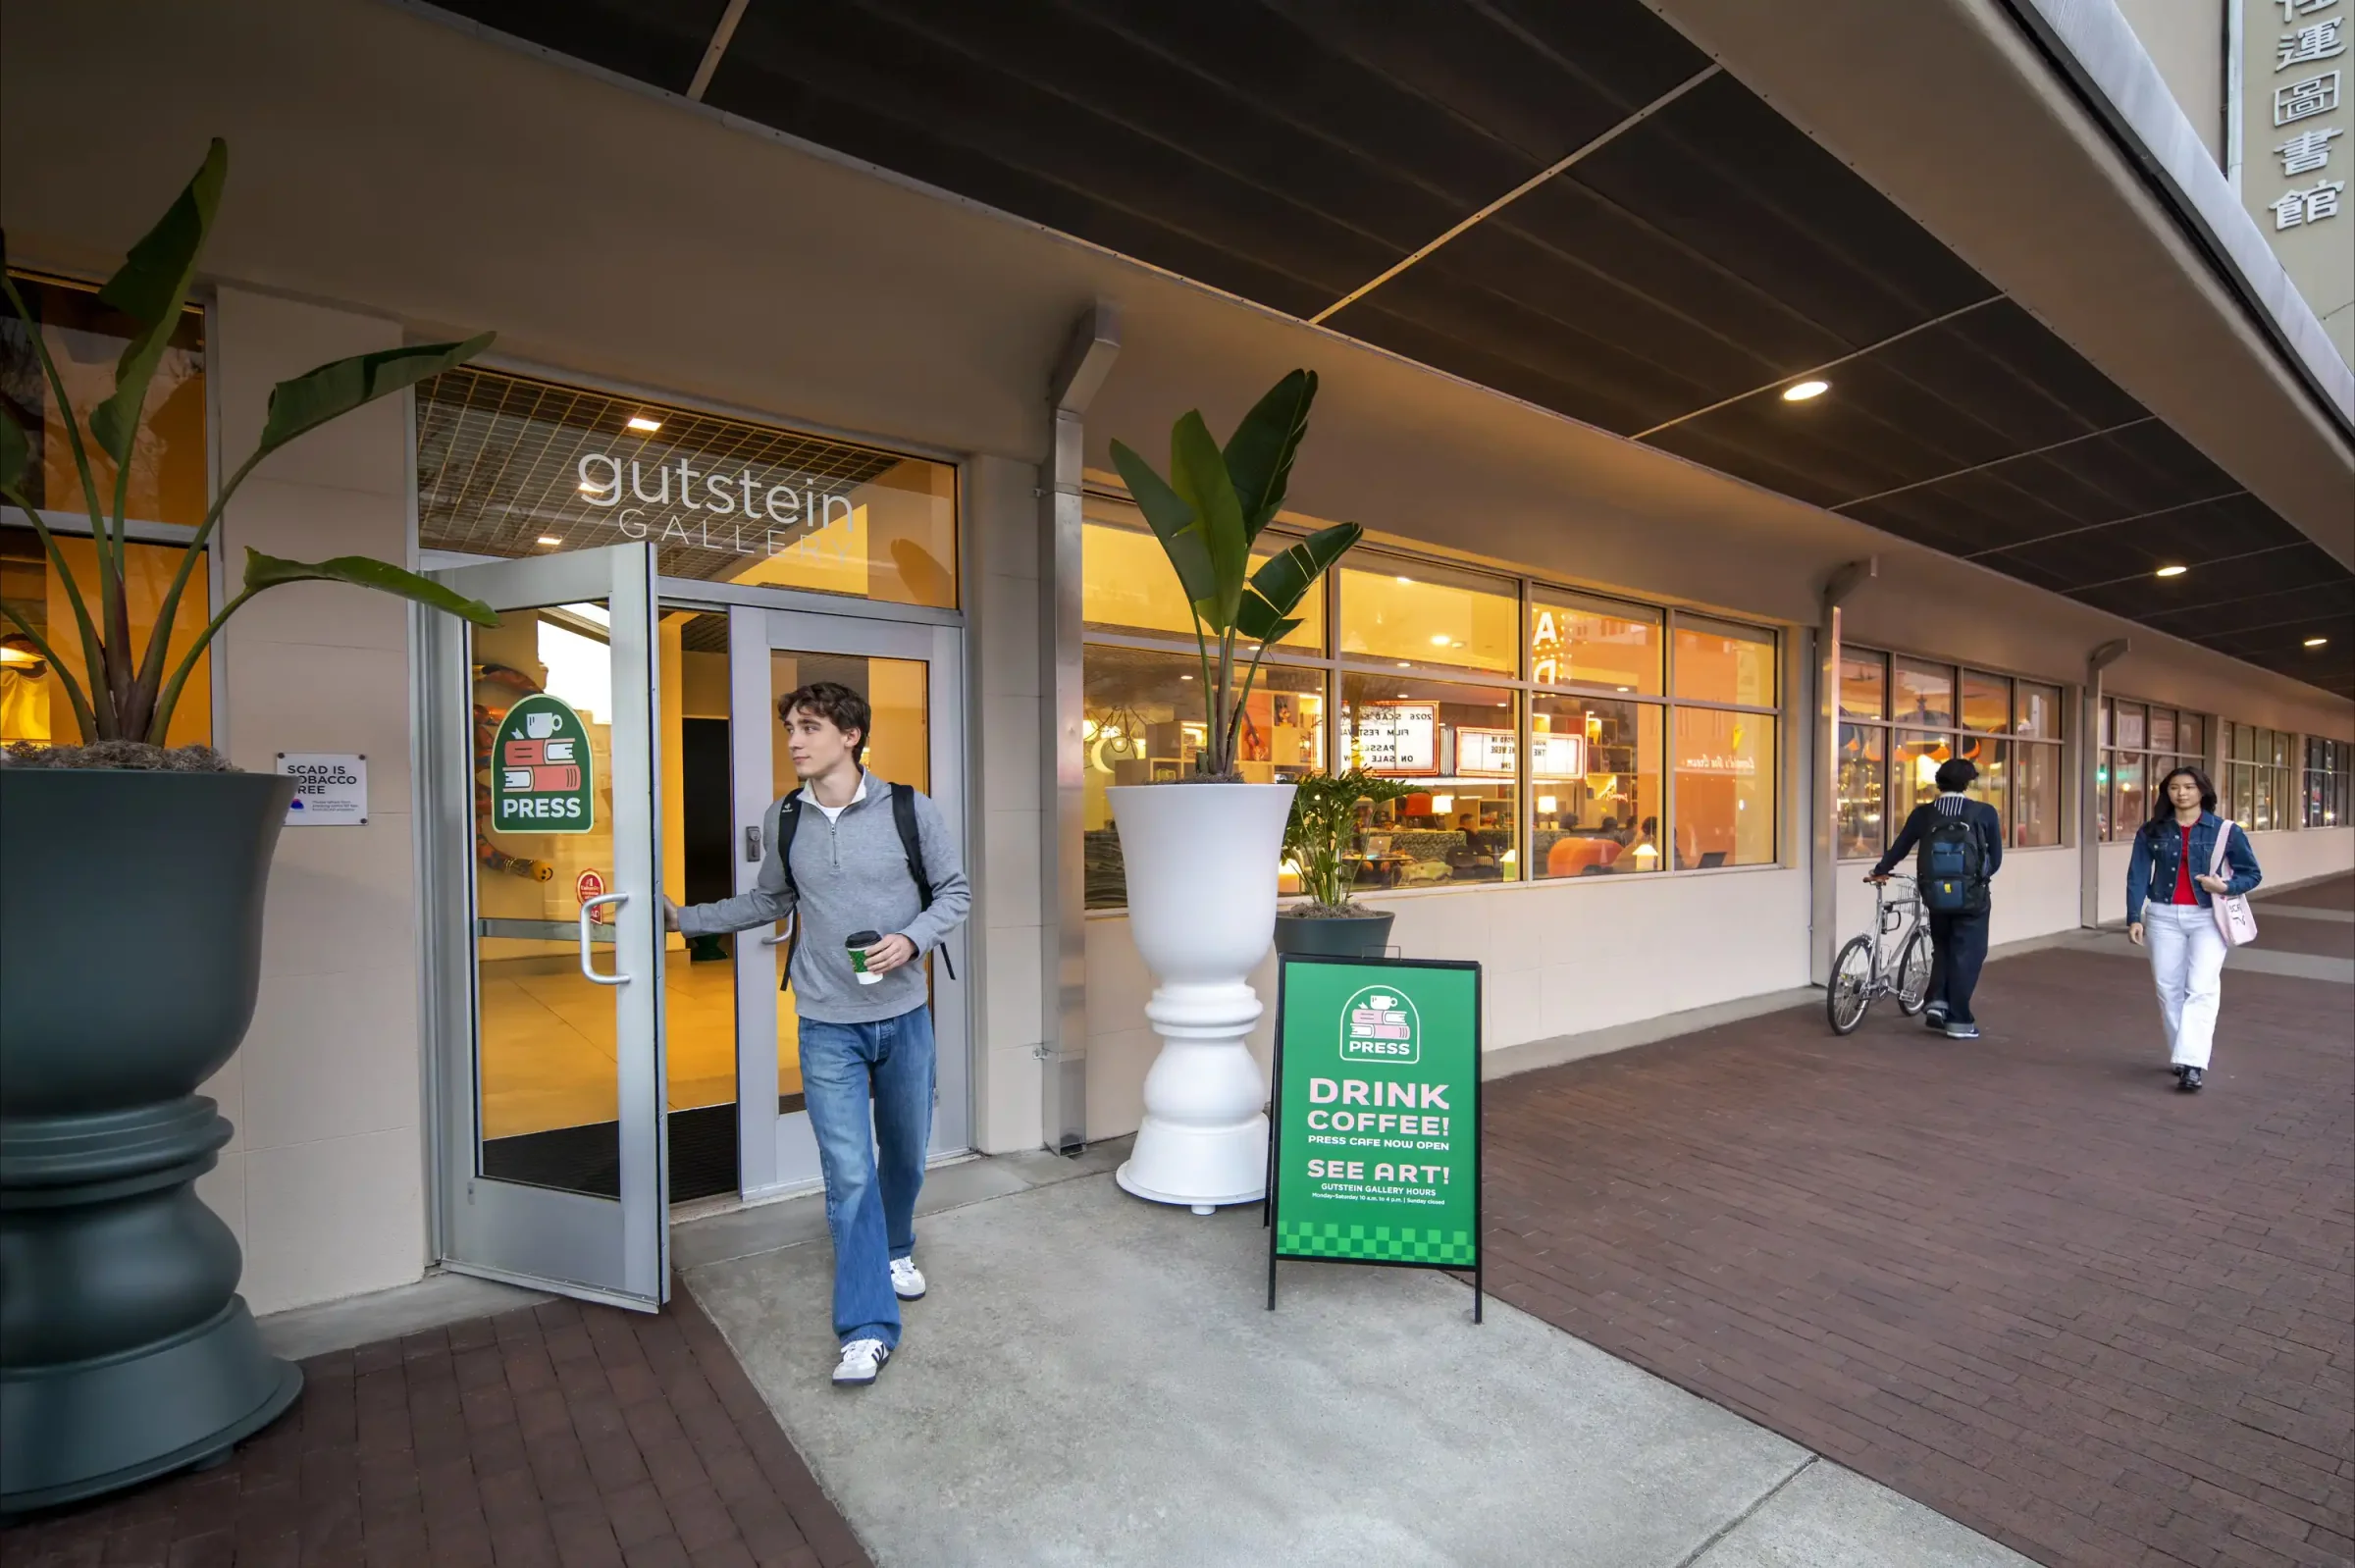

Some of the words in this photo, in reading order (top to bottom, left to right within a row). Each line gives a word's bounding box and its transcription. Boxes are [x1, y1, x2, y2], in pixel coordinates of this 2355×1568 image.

[578, 452, 853, 533] gutstein
[619, 508, 854, 567] GALLERY
[288, 765, 329, 775] SCAD
[334, 765, 345, 775] IS
[298, 775, 357, 784] OBACCO
[297, 785, 326, 794] REE
[502, 797, 581, 818] PRESS
[1349, 1040, 1410, 1055] PRESS
[1310, 1077, 1449, 1110] DRINK
[1307, 1110, 1449, 1136] COFFEE!
[1308, 1135, 1346, 1145] PRESS
[1349, 1137, 1381, 1147] CAFE
[1384, 1139, 1413, 1149] NOW
[1416, 1141, 1449, 1150] OPEN
[1307, 1159, 1364, 1179] SEE
[1375, 1163, 1449, 1184] ART!
[1321, 1182, 1363, 1192] GUTSTEIN
[1365, 1185, 1404, 1194] GALLERY
[1406, 1187, 1437, 1196] HOURS
